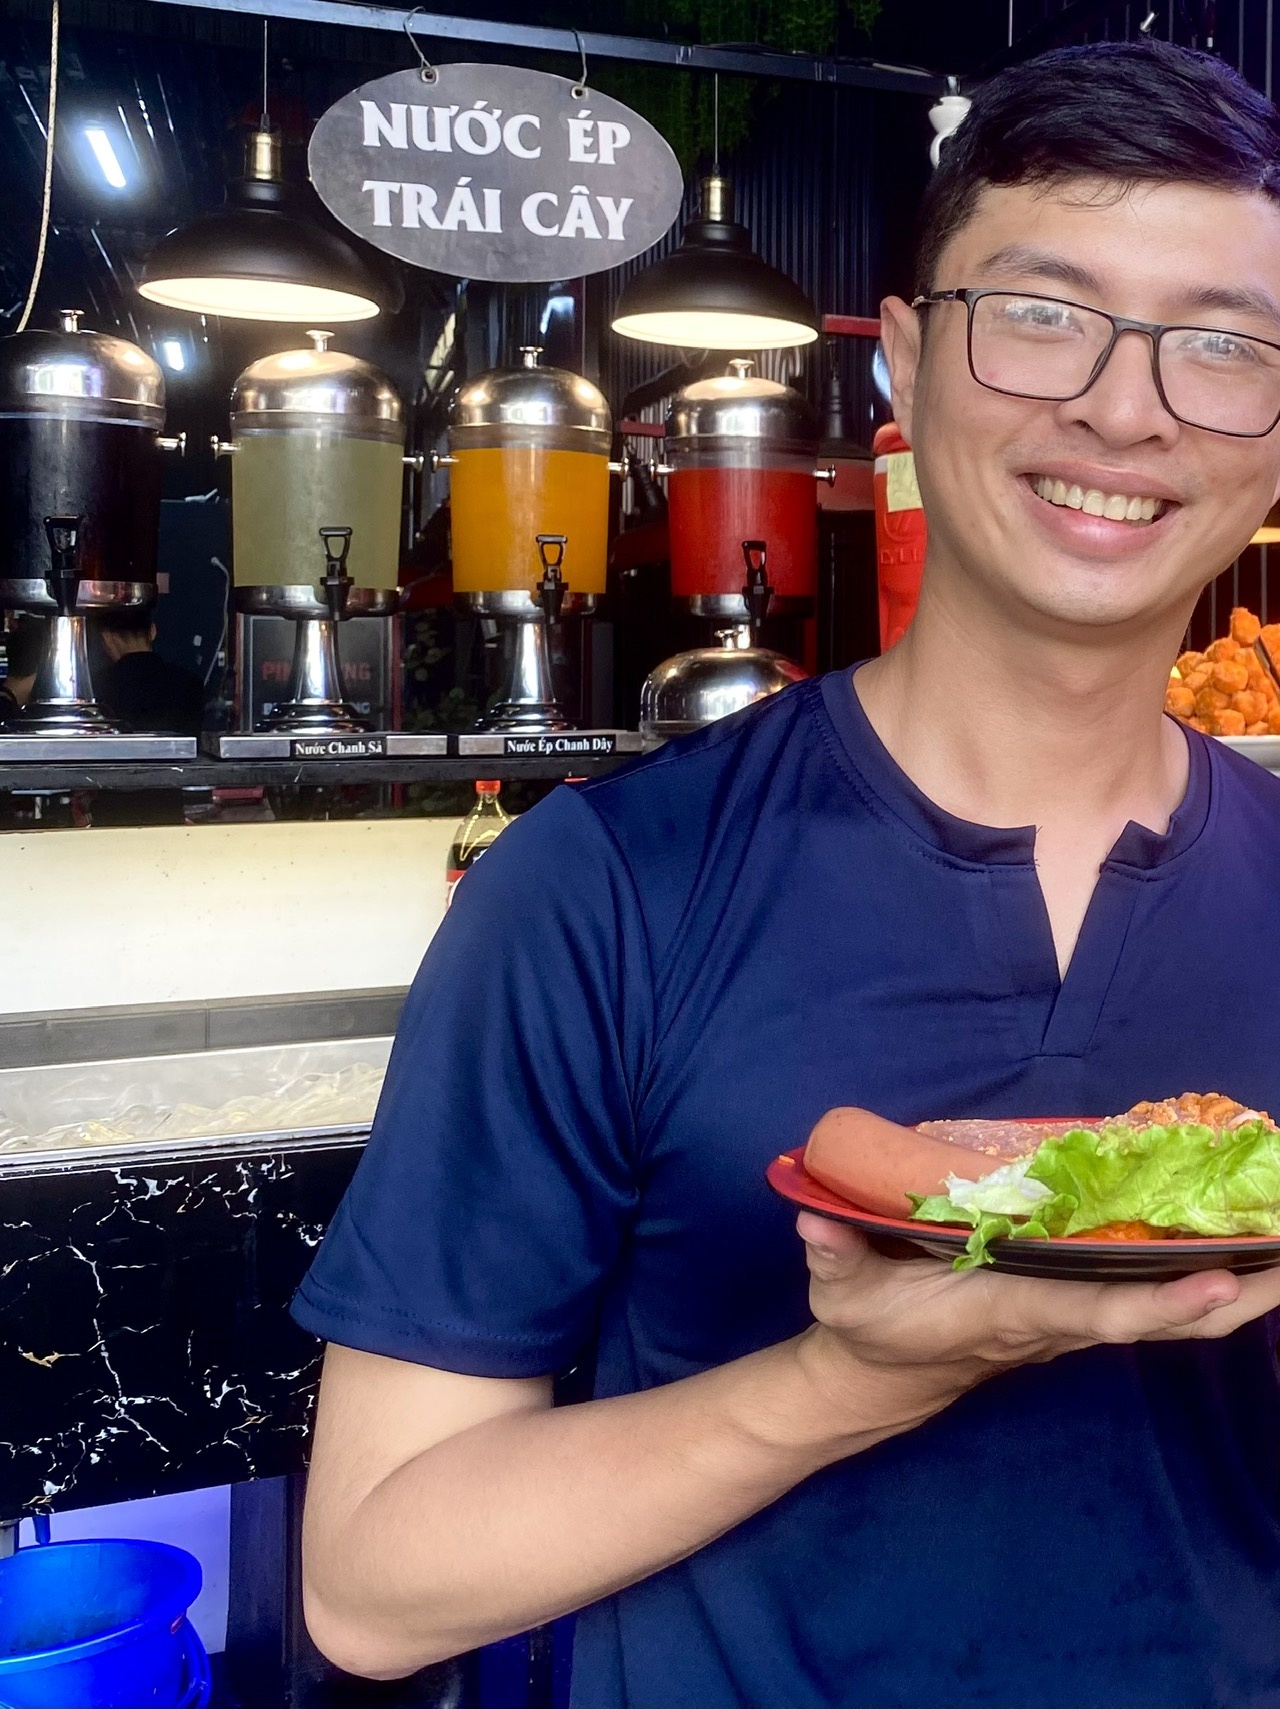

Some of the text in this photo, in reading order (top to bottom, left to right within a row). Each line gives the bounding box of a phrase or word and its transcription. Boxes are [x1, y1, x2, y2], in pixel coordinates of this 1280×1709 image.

[360, 100, 631, 165] NƯỚC ÉP
[362, 176, 634, 241] TRÁI CÂY
[295, 742, 326, 755] Nước
[328, 741, 365, 754] Chanh
[507, 737, 613, 755] Nước Ép Chanh Dây
